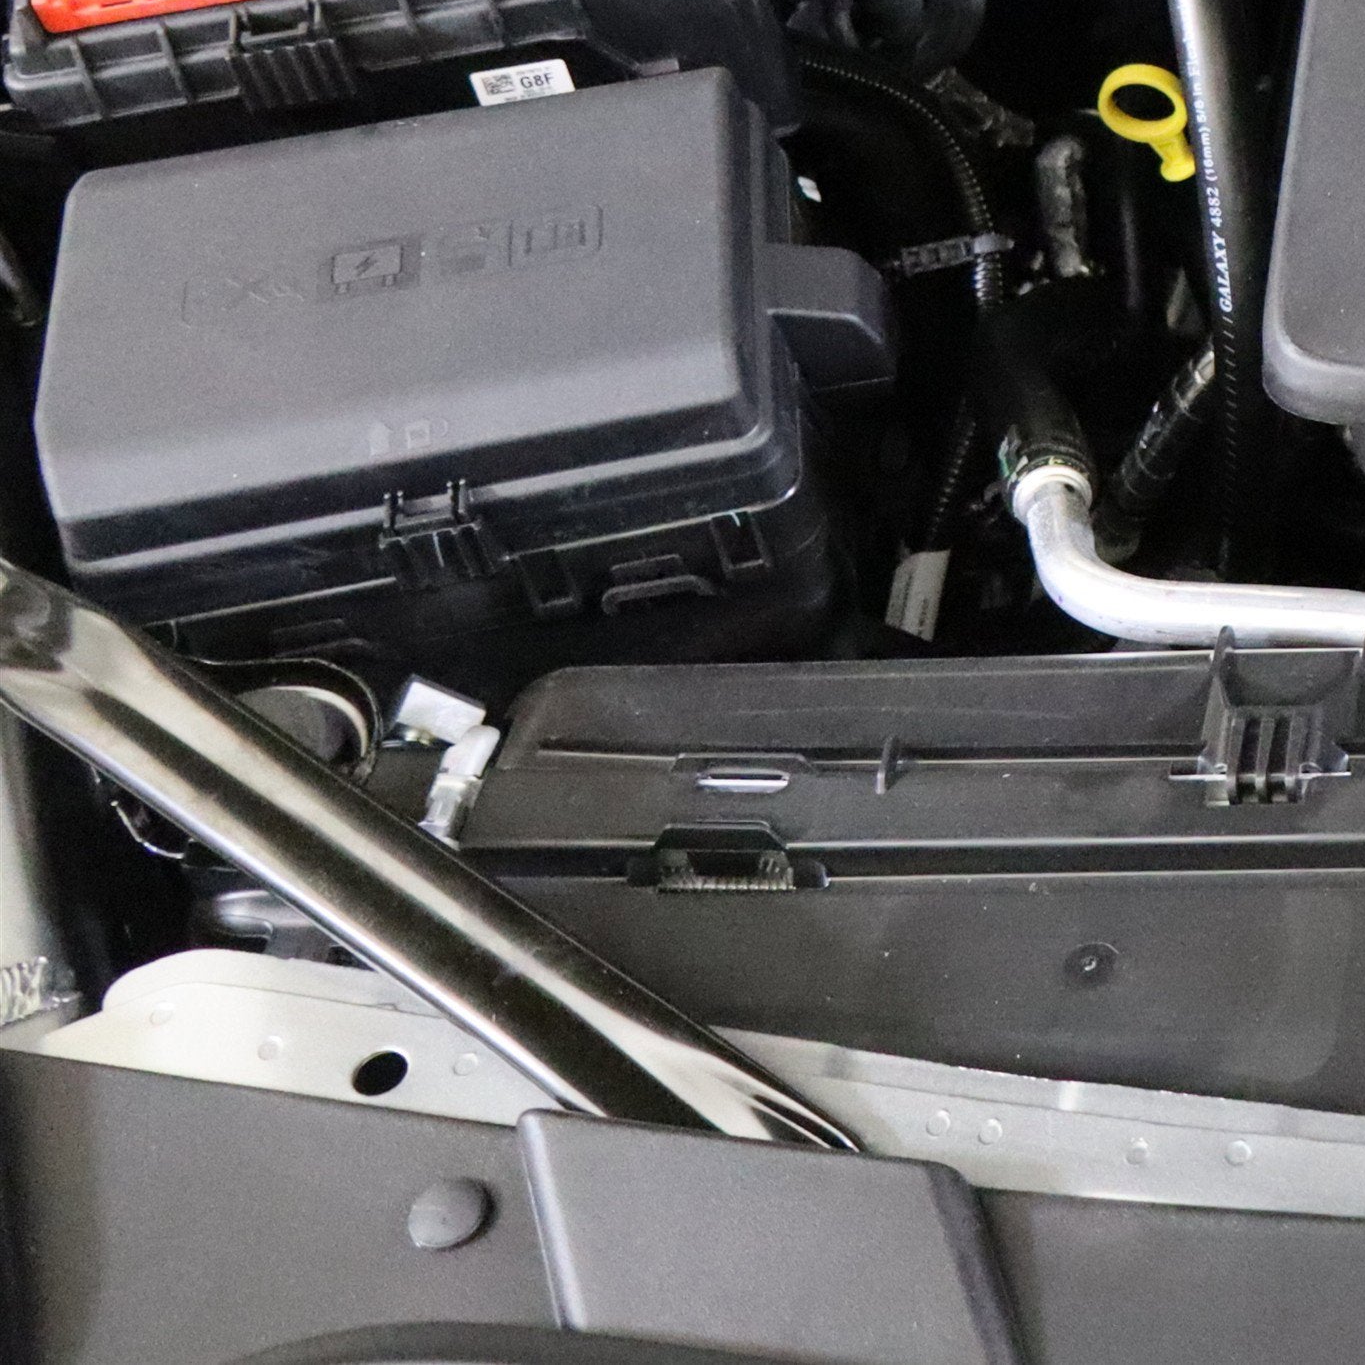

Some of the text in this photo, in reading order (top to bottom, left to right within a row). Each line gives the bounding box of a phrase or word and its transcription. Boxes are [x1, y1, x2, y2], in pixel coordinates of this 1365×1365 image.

[519, 73, 554, 89] G8F
[1198, 126, 1219, 182] (16mm)
[1206, 186, 1224, 228] 4882
[1211, 231, 1233, 313] GALAXY
